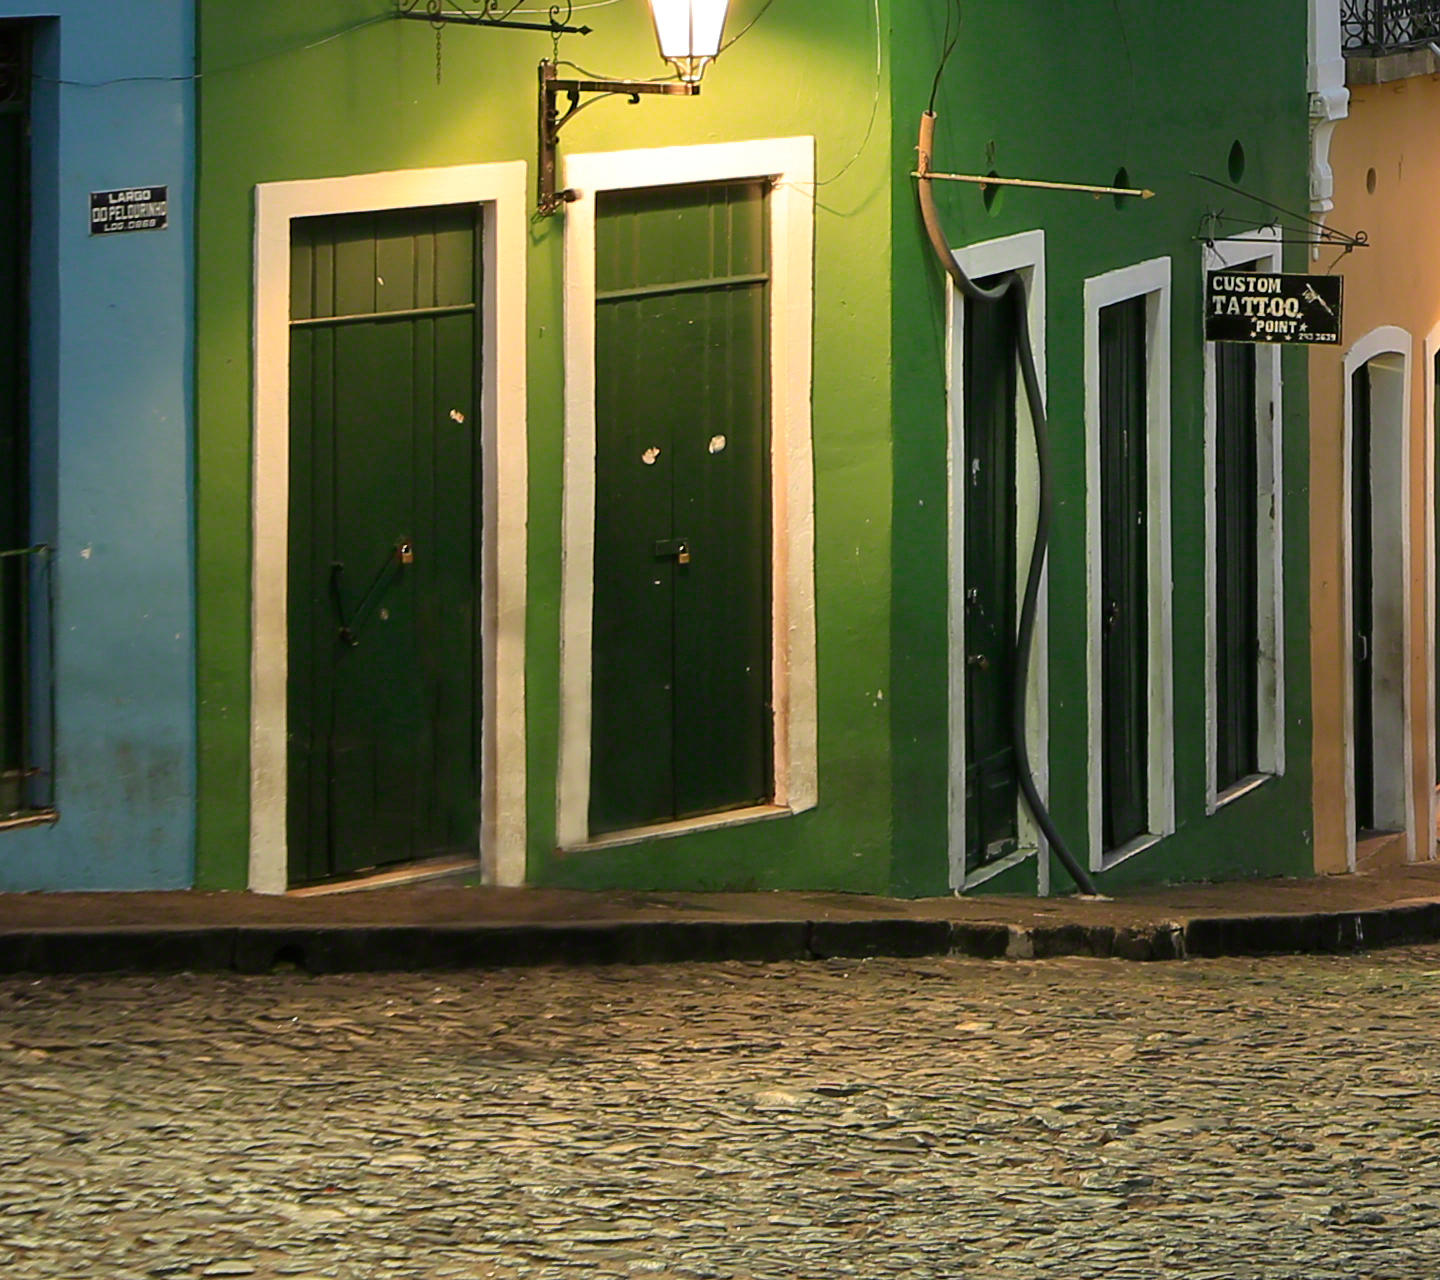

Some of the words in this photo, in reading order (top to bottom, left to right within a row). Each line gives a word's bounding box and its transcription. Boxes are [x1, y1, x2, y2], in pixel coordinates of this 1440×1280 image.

[108, 189, 152, 204] LARGO
[92, 206, 108, 223] DO
[109, 200, 168, 221] PELOURINHO
[1212, 276, 1282, 294] CUSTOM
[1212, 295, 1300, 318] TATTOO
[1255, 320, 1298, 334] POINT
